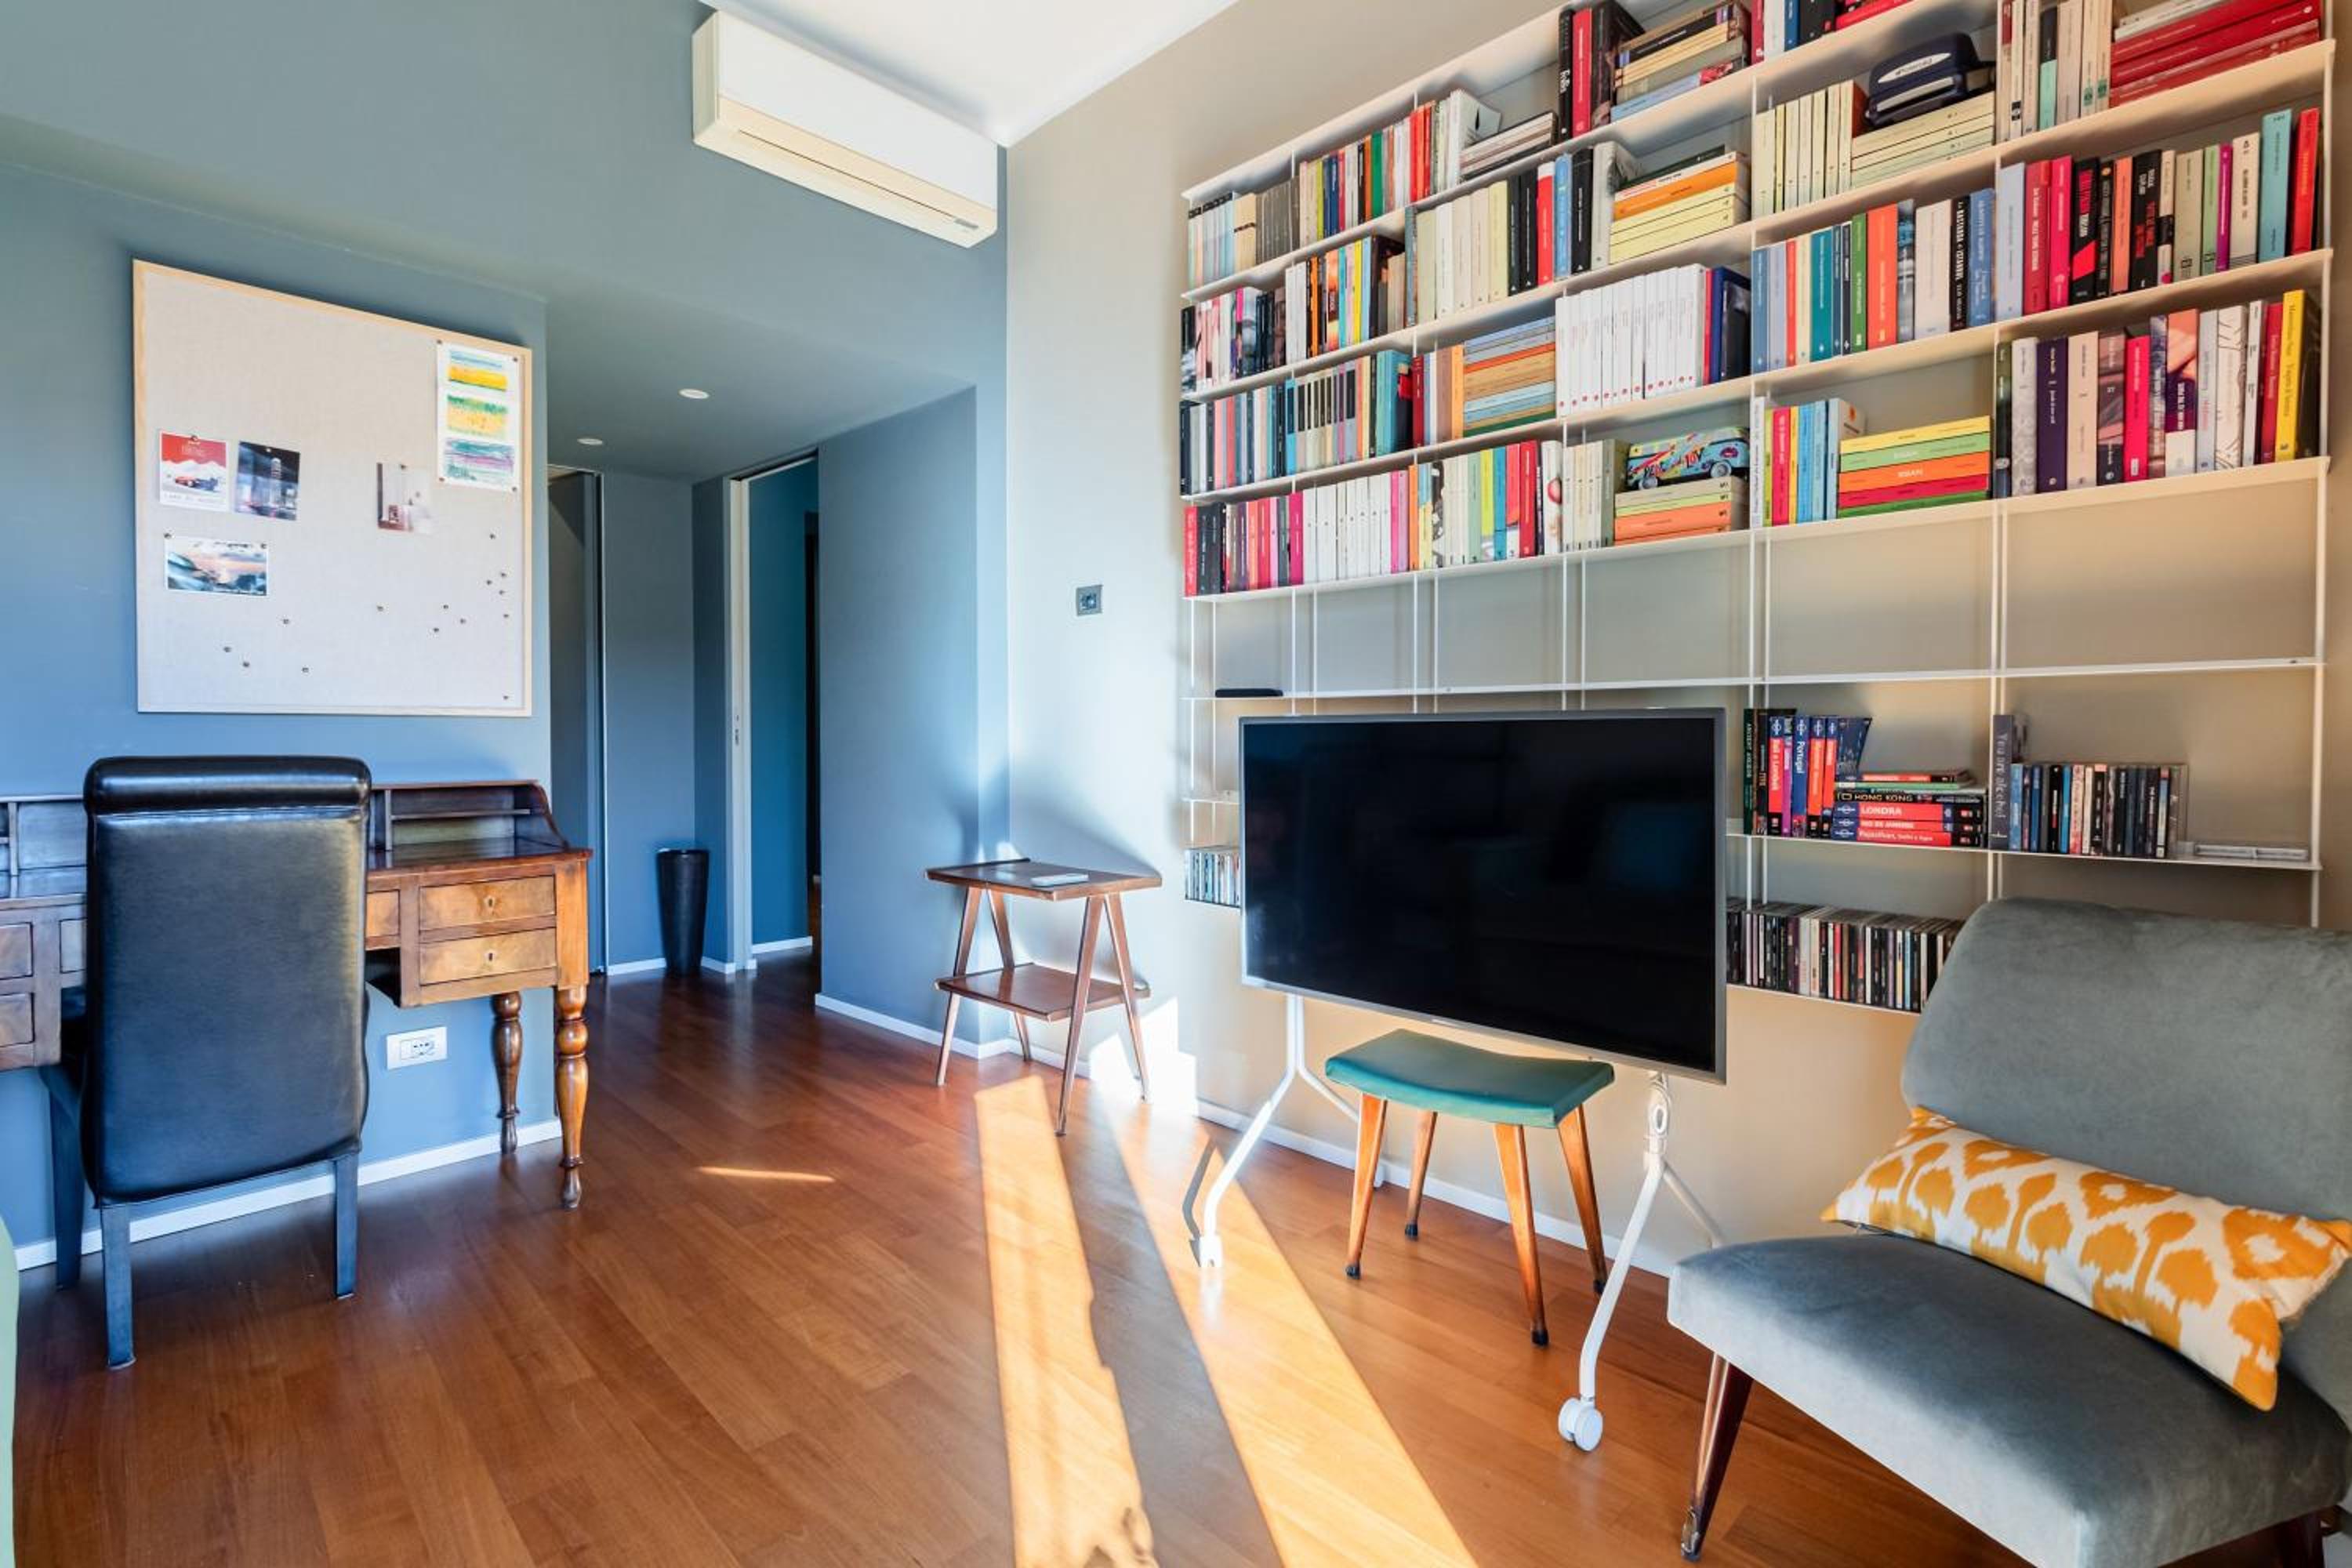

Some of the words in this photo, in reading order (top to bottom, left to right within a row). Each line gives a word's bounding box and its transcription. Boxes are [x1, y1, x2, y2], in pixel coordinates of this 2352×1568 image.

[1795, 741, 1806, 774] Portugal
[1855, 793, 1882, 801] HONG
[1886, 794, 1914, 803] KONG
[1860, 807, 1902, 816] LONDRA
